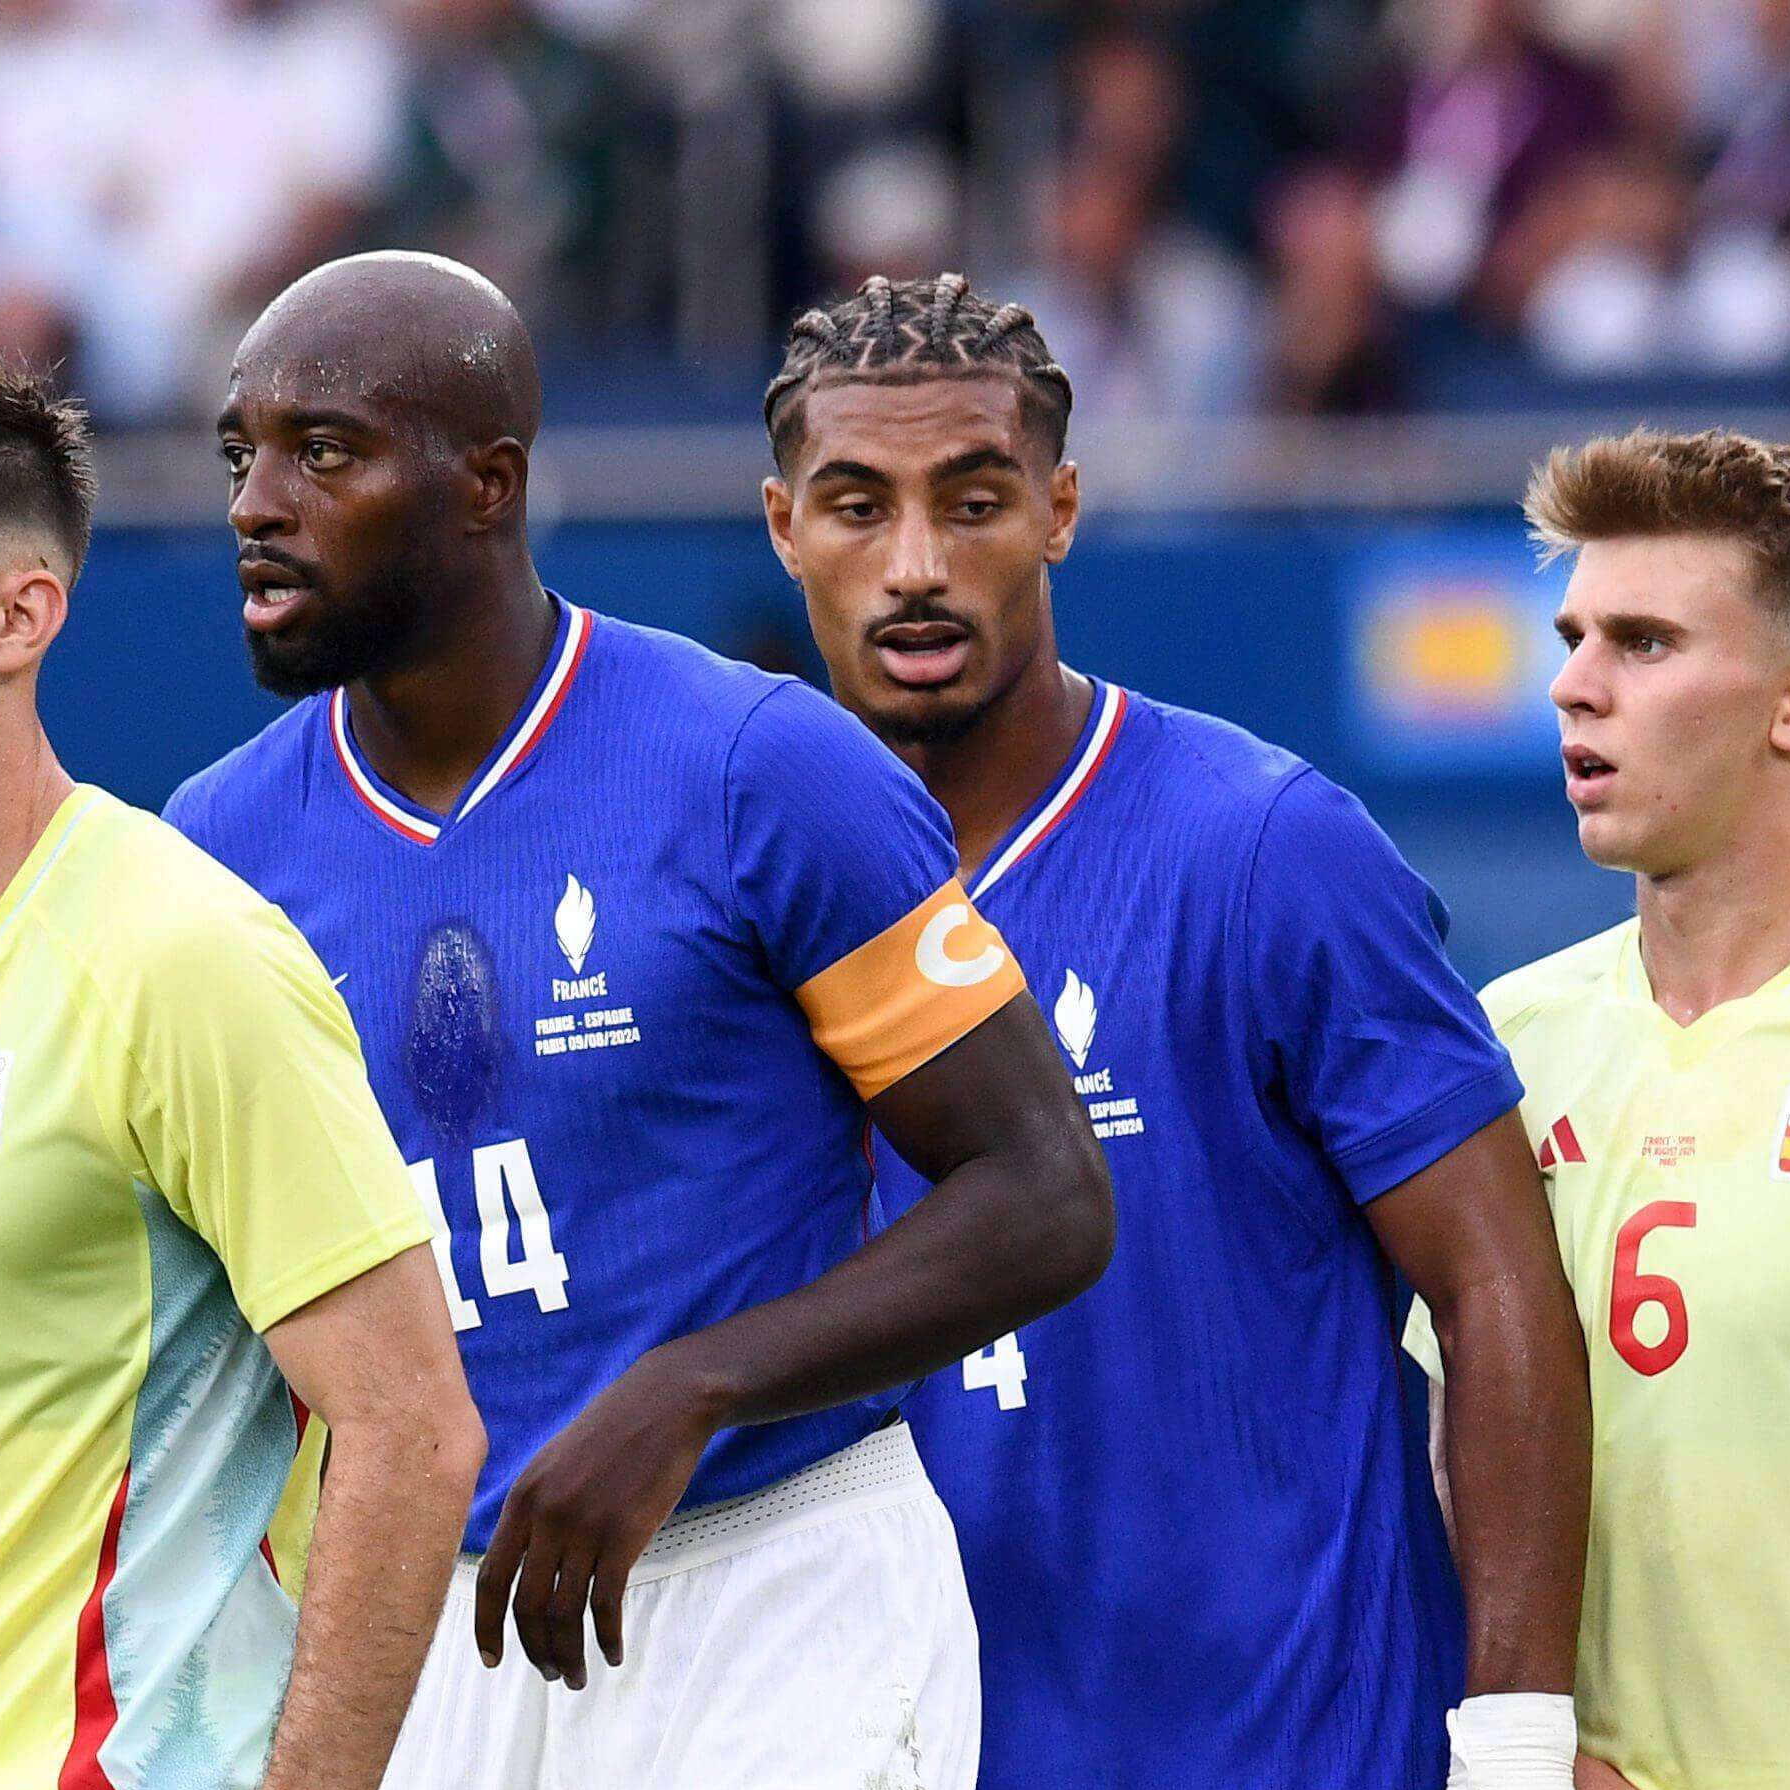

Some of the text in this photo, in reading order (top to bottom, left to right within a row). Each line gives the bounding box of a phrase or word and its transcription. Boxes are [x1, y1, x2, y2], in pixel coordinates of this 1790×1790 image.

[915, 903, 1005, 987] C
[552, 971, 608, 1002] FRANCE
[535, 1014, 575, 1036] FRANCE
[583, 1007, 634, 1029] ESPAGNE
[535, 1026, 641, 1056] PARIS 09/08/2024
[1609, 1200, 1696, 1377] 6
